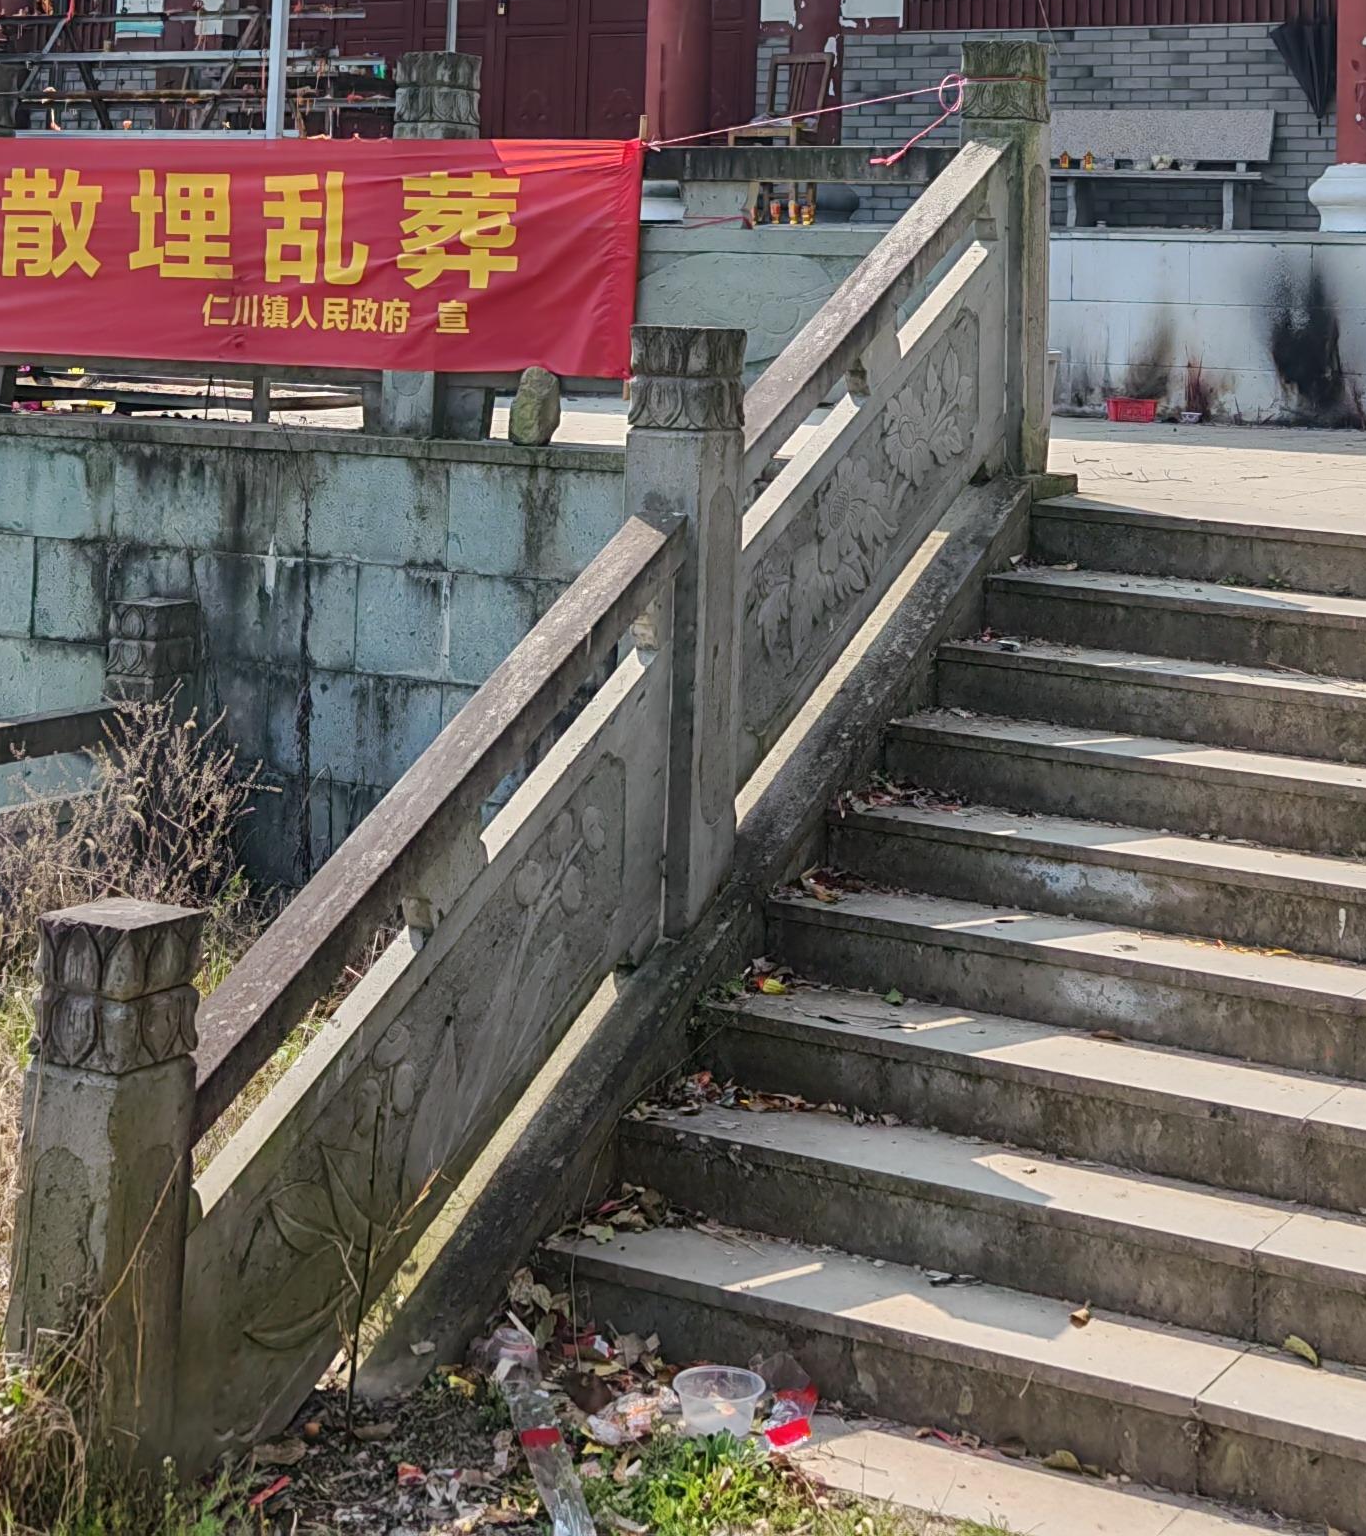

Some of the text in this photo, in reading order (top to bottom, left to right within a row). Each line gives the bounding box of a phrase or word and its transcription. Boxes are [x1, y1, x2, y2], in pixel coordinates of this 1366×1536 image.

[202, 293, 471, 334] 仁川镇人民政府 宣
